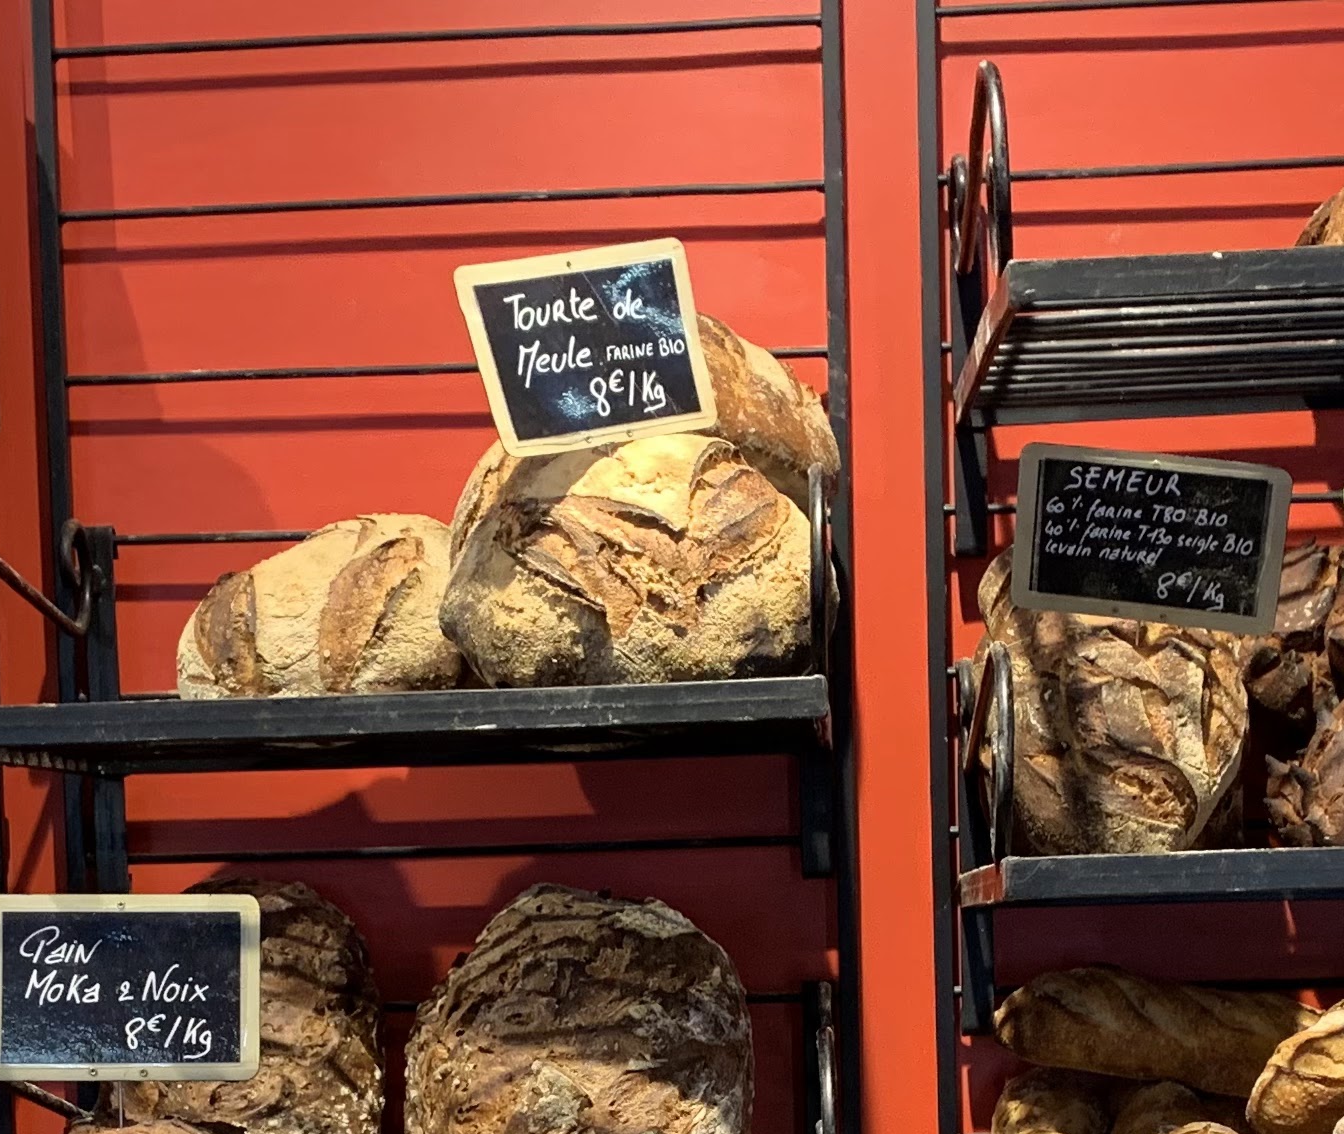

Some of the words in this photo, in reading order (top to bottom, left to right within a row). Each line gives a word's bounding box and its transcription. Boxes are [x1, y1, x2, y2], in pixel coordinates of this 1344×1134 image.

[503, 287, 597, 331] Tourte
[613, 288, 646, 320] de
[606, 345, 654, 362] FARINE
[658, 337, 684, 357] BIO
[1064, 466, 1181, 496] SEMEUR
[1086, 499, 1142, 522] farine
[1152, 505, 1186, 524] T80
[1195, 509, 1228, 527] BIO
[1045, 540, 1091, 557] levain
[1099, 547, 1163, 566] naturel
[1080, 523, 1131, 543] farine
[1138, 525, 1173, 545] T130
[1178, 533, 1218, 554] seigle
[1223, 534, 1253, 555] BIO
[19, 925, 103, 964] Pain
[142, 963, 209, 1002] Noix
